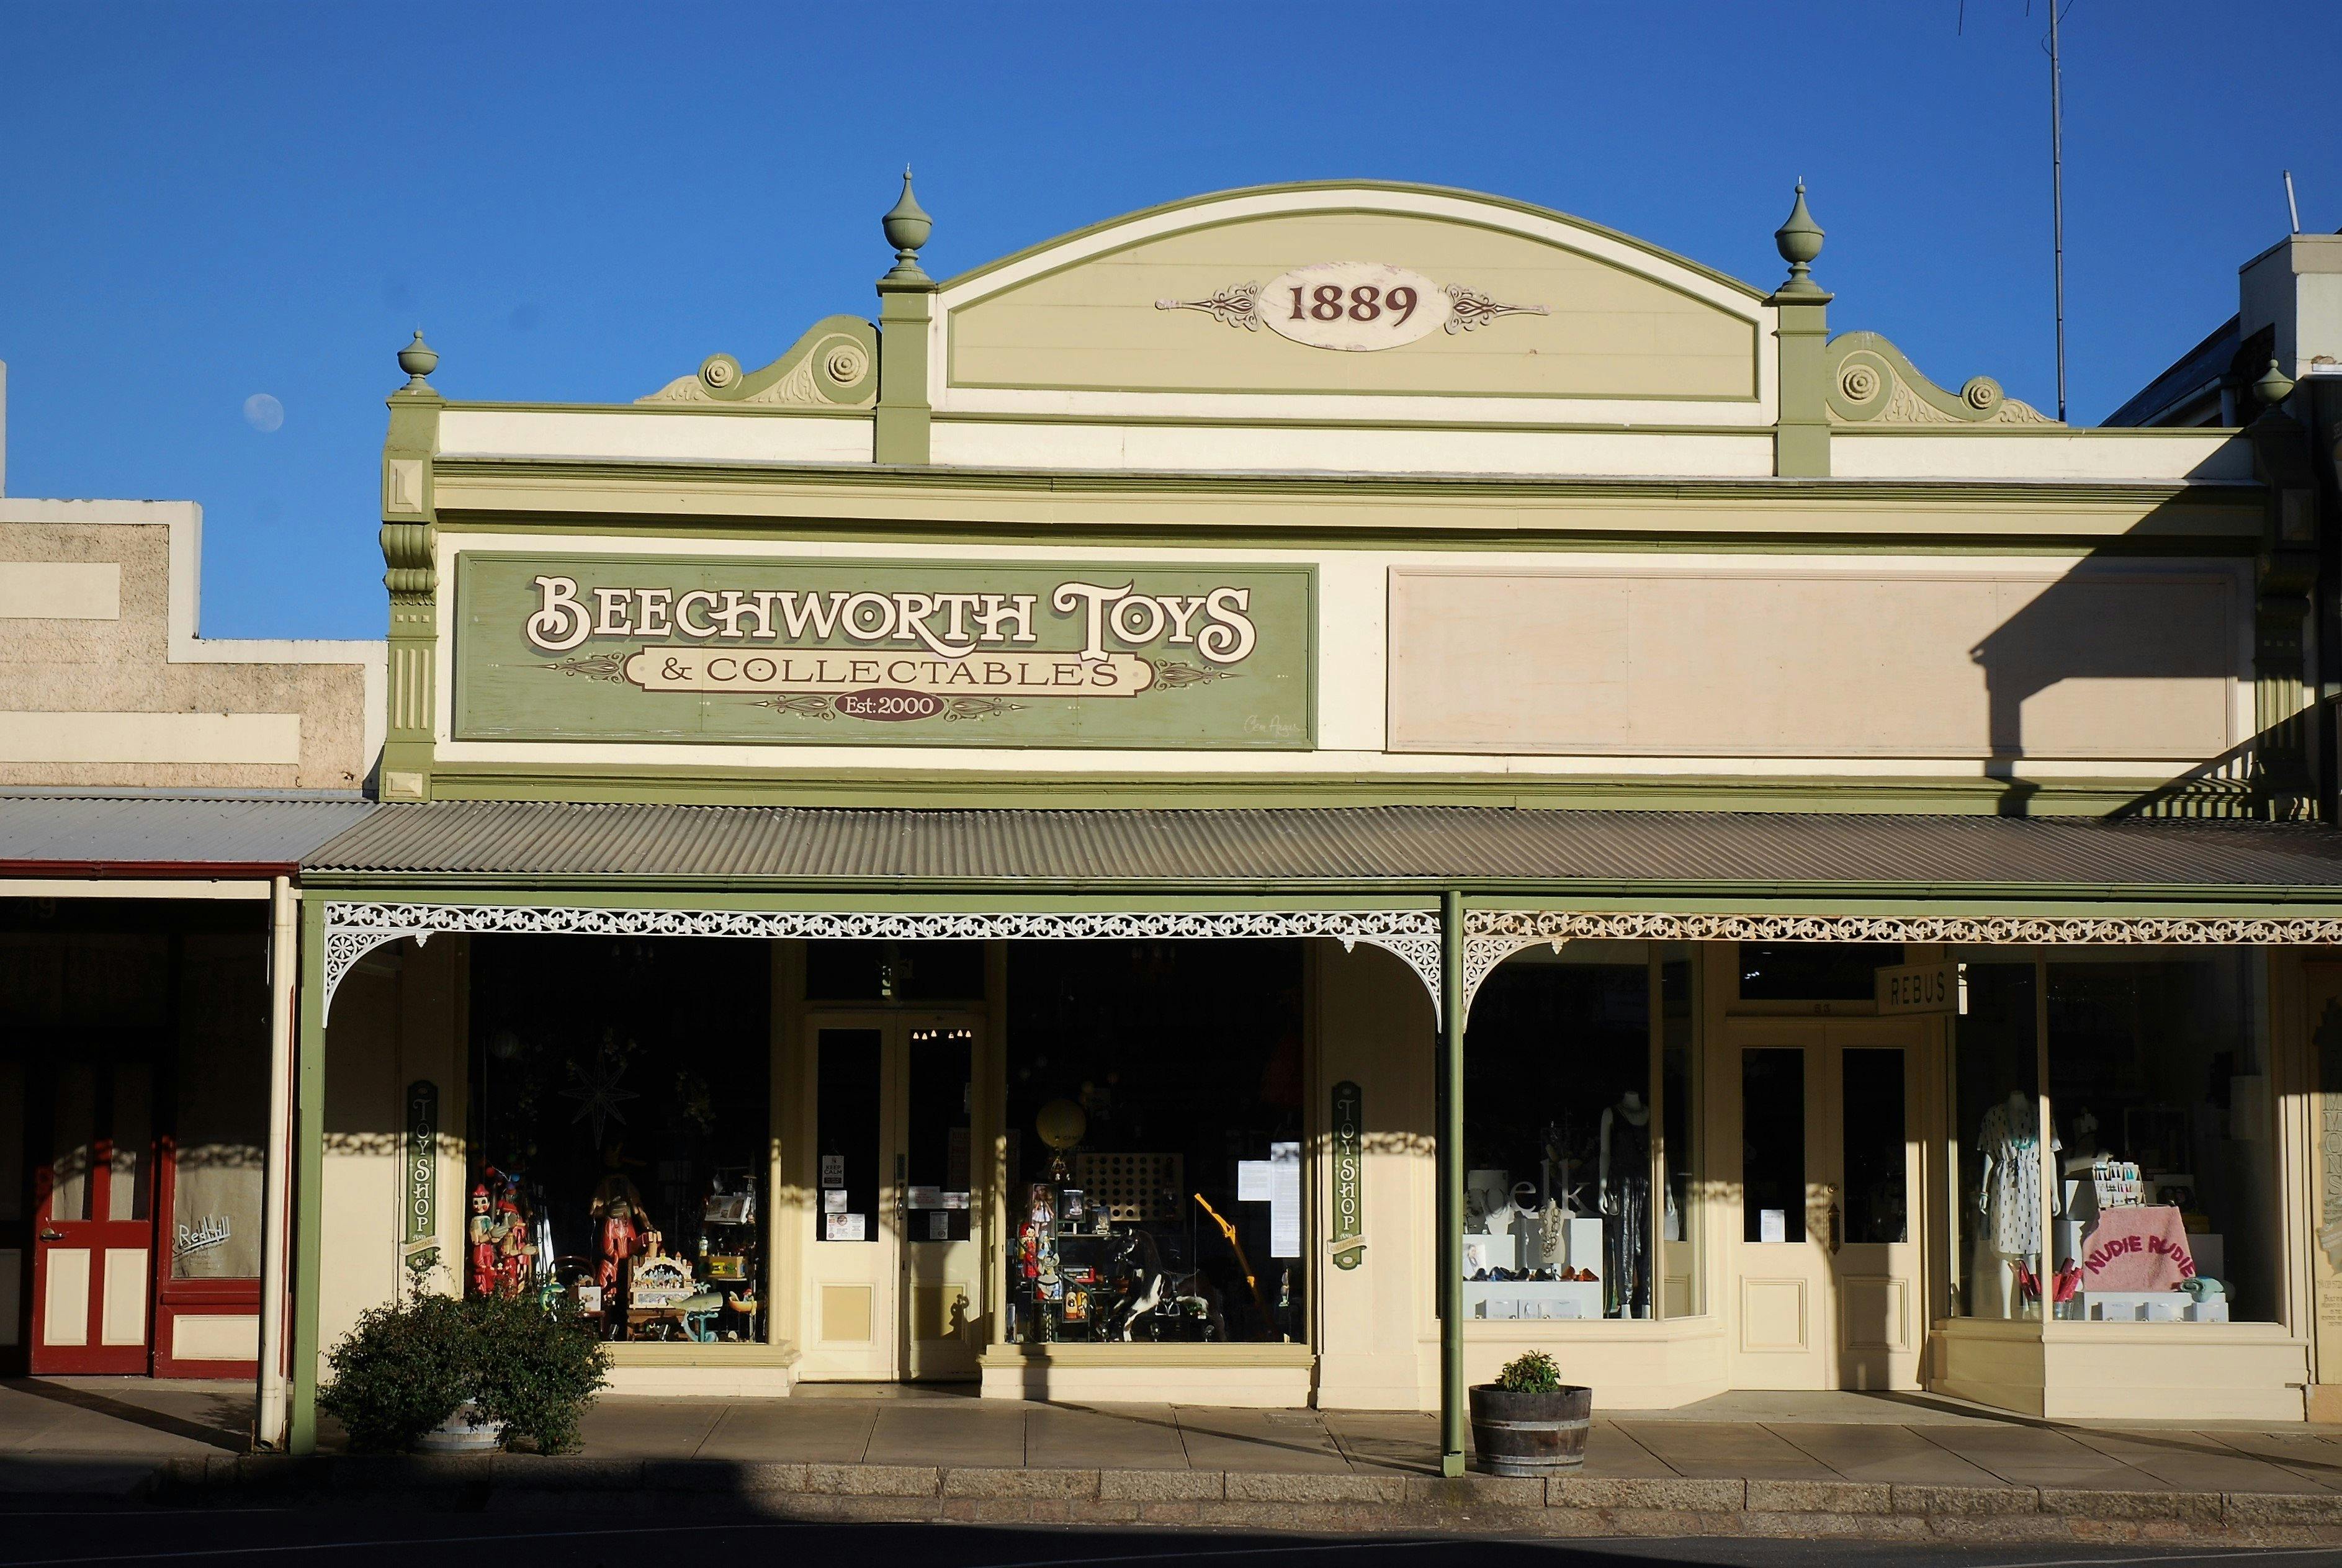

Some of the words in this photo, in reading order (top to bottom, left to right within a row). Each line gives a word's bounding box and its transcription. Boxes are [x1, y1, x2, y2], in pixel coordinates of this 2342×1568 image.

[1288, 285, 1418, 327] 1889
[526, 574, 1038, 660] BEECHWORTH
[1053, 578, 1257, 665] TOYS
[661, 658, 694, 681] &
[706, 656, 1119, 688] COLLECTABLES
[878, 695, 935, 715] 2000
[1891, 971, 1945, 1006] REBUS
[1510, 1158, 1597, 1219] elk
[2084, 1235, 2143, 1275] NUDIE
[2148, 1235, 2197, 1278] RUDIE
